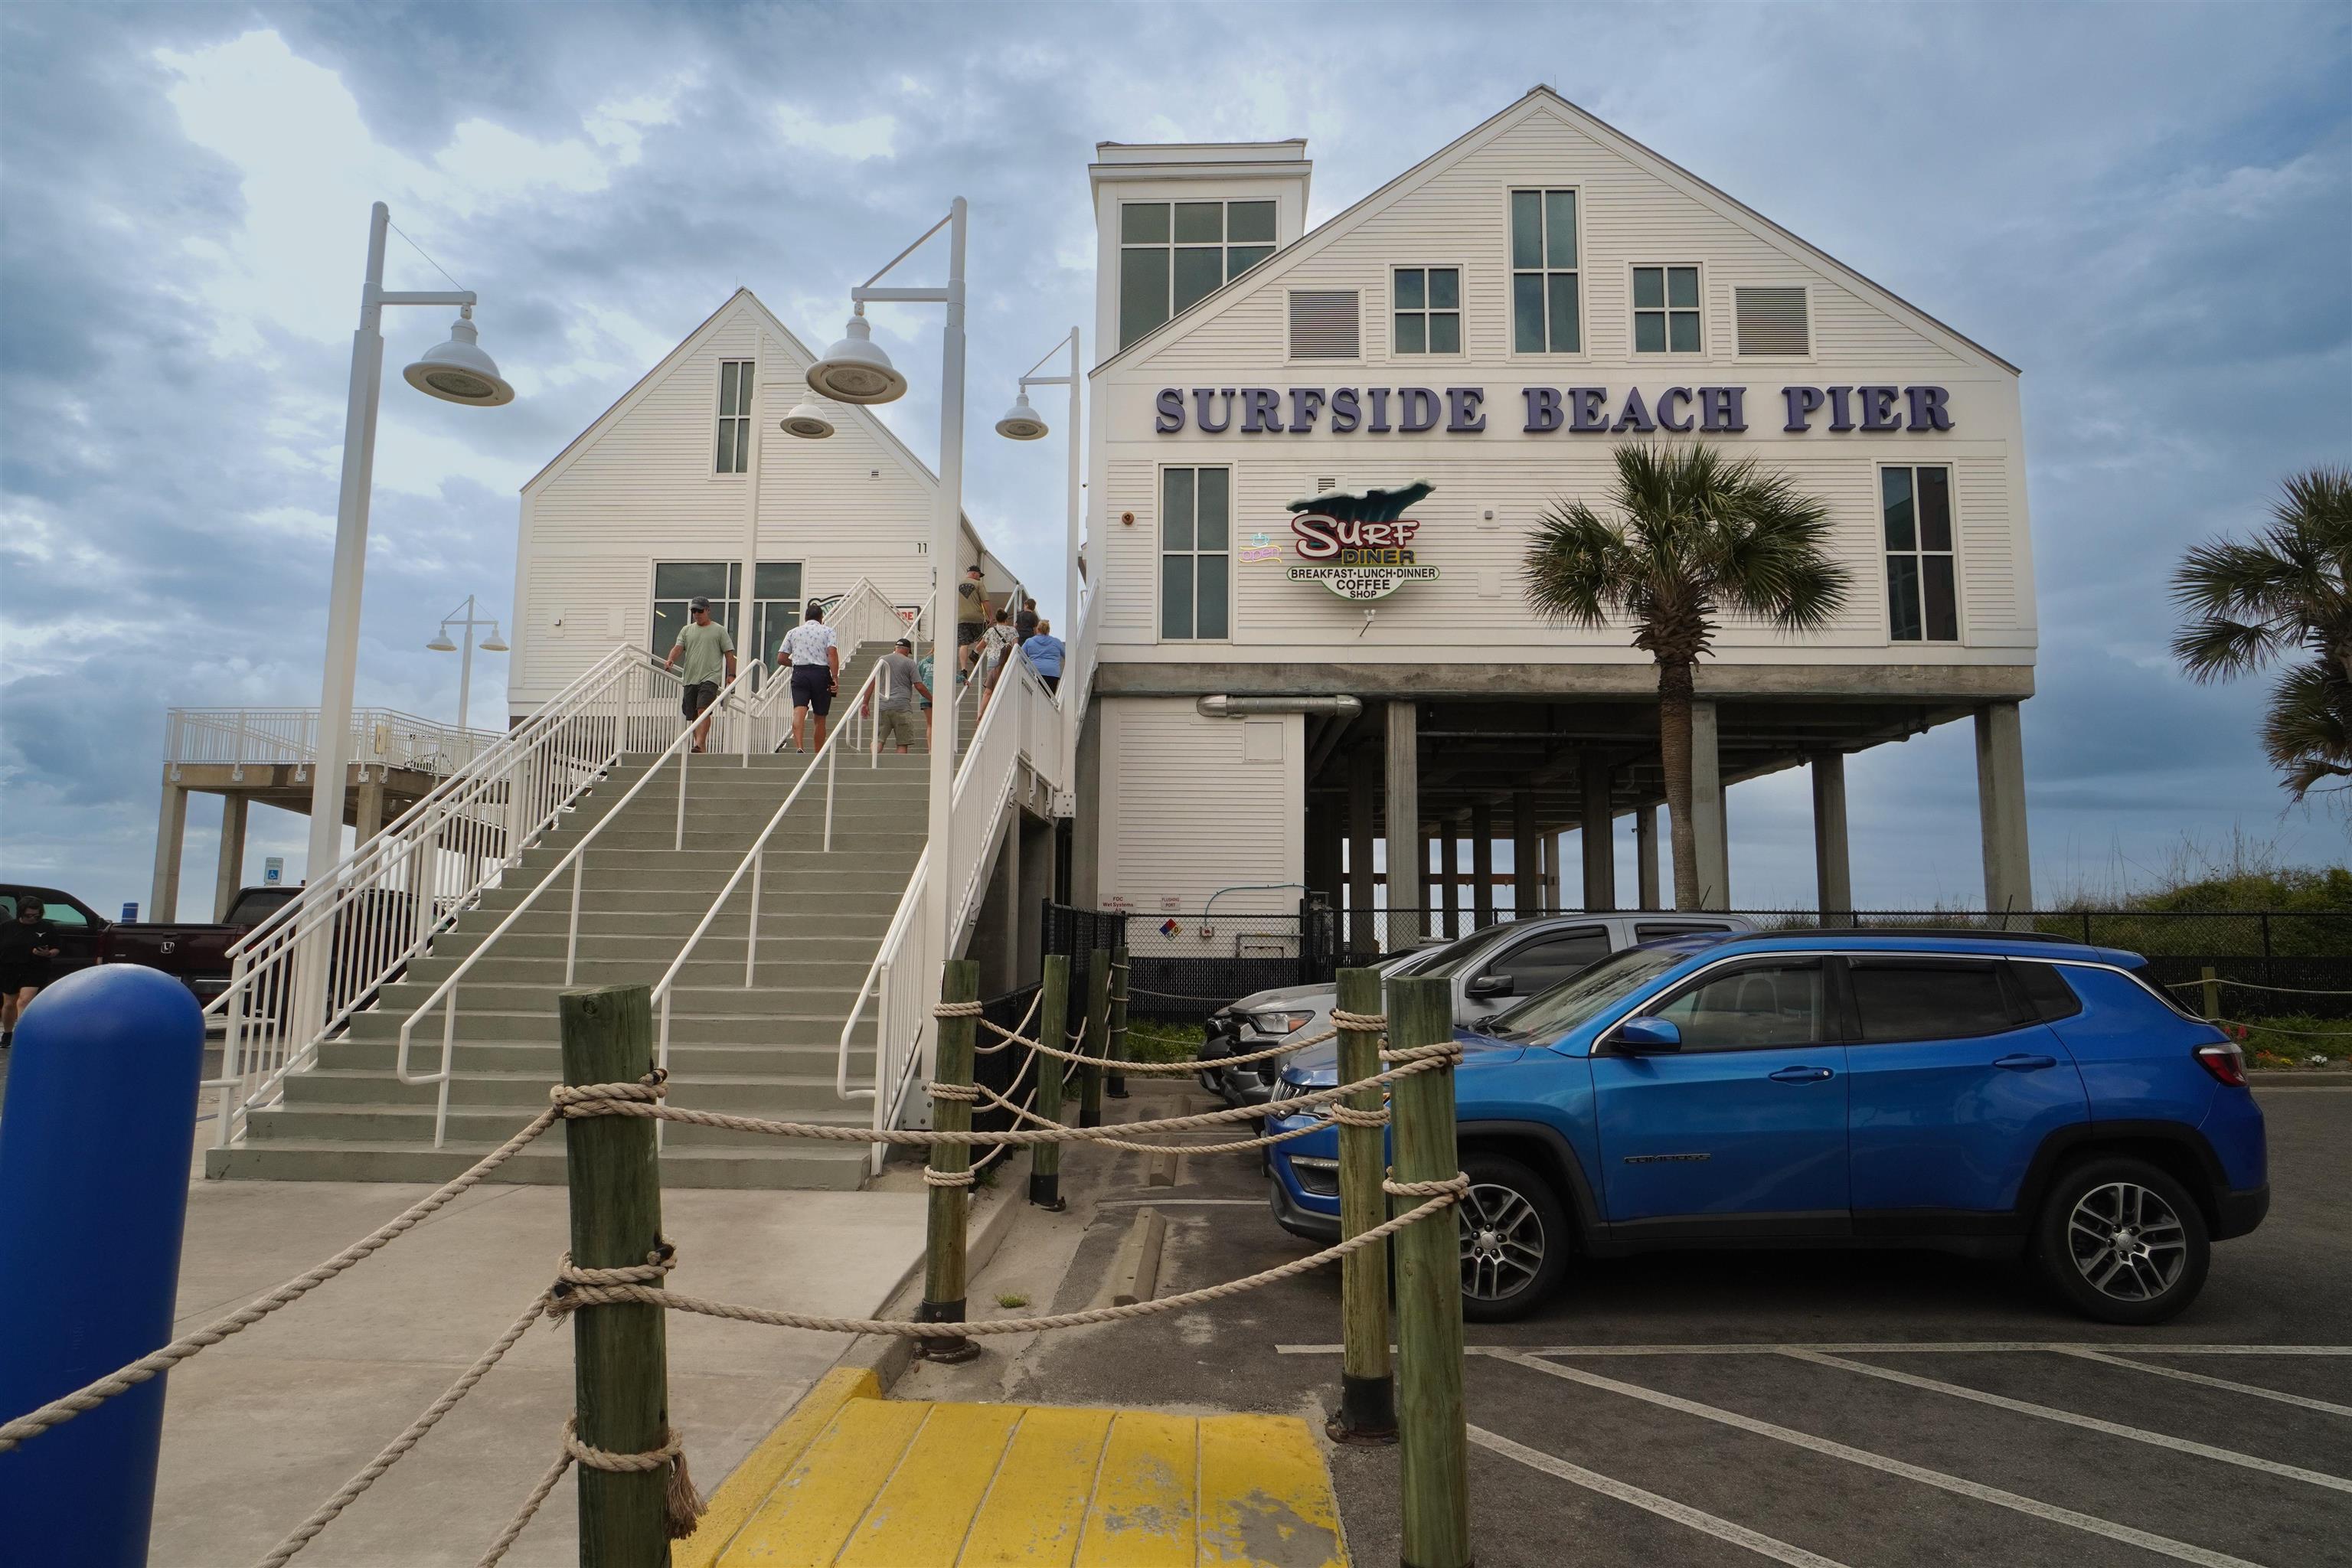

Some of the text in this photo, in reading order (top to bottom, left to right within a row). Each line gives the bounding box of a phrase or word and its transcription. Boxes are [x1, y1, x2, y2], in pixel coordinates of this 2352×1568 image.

[1155, 386, 1956, 433] SURFSIDE BEACH PIER
[1292, 514, 1419, 560] SURF
[916, 543, 927, 554] 11
[1242, 547, 1279, 563] open
[1342, 549, 1416, 565] DINER
[1336, 579, 1391, 590] COFFEE
[1349, 590, 1377, 599] SHOP
